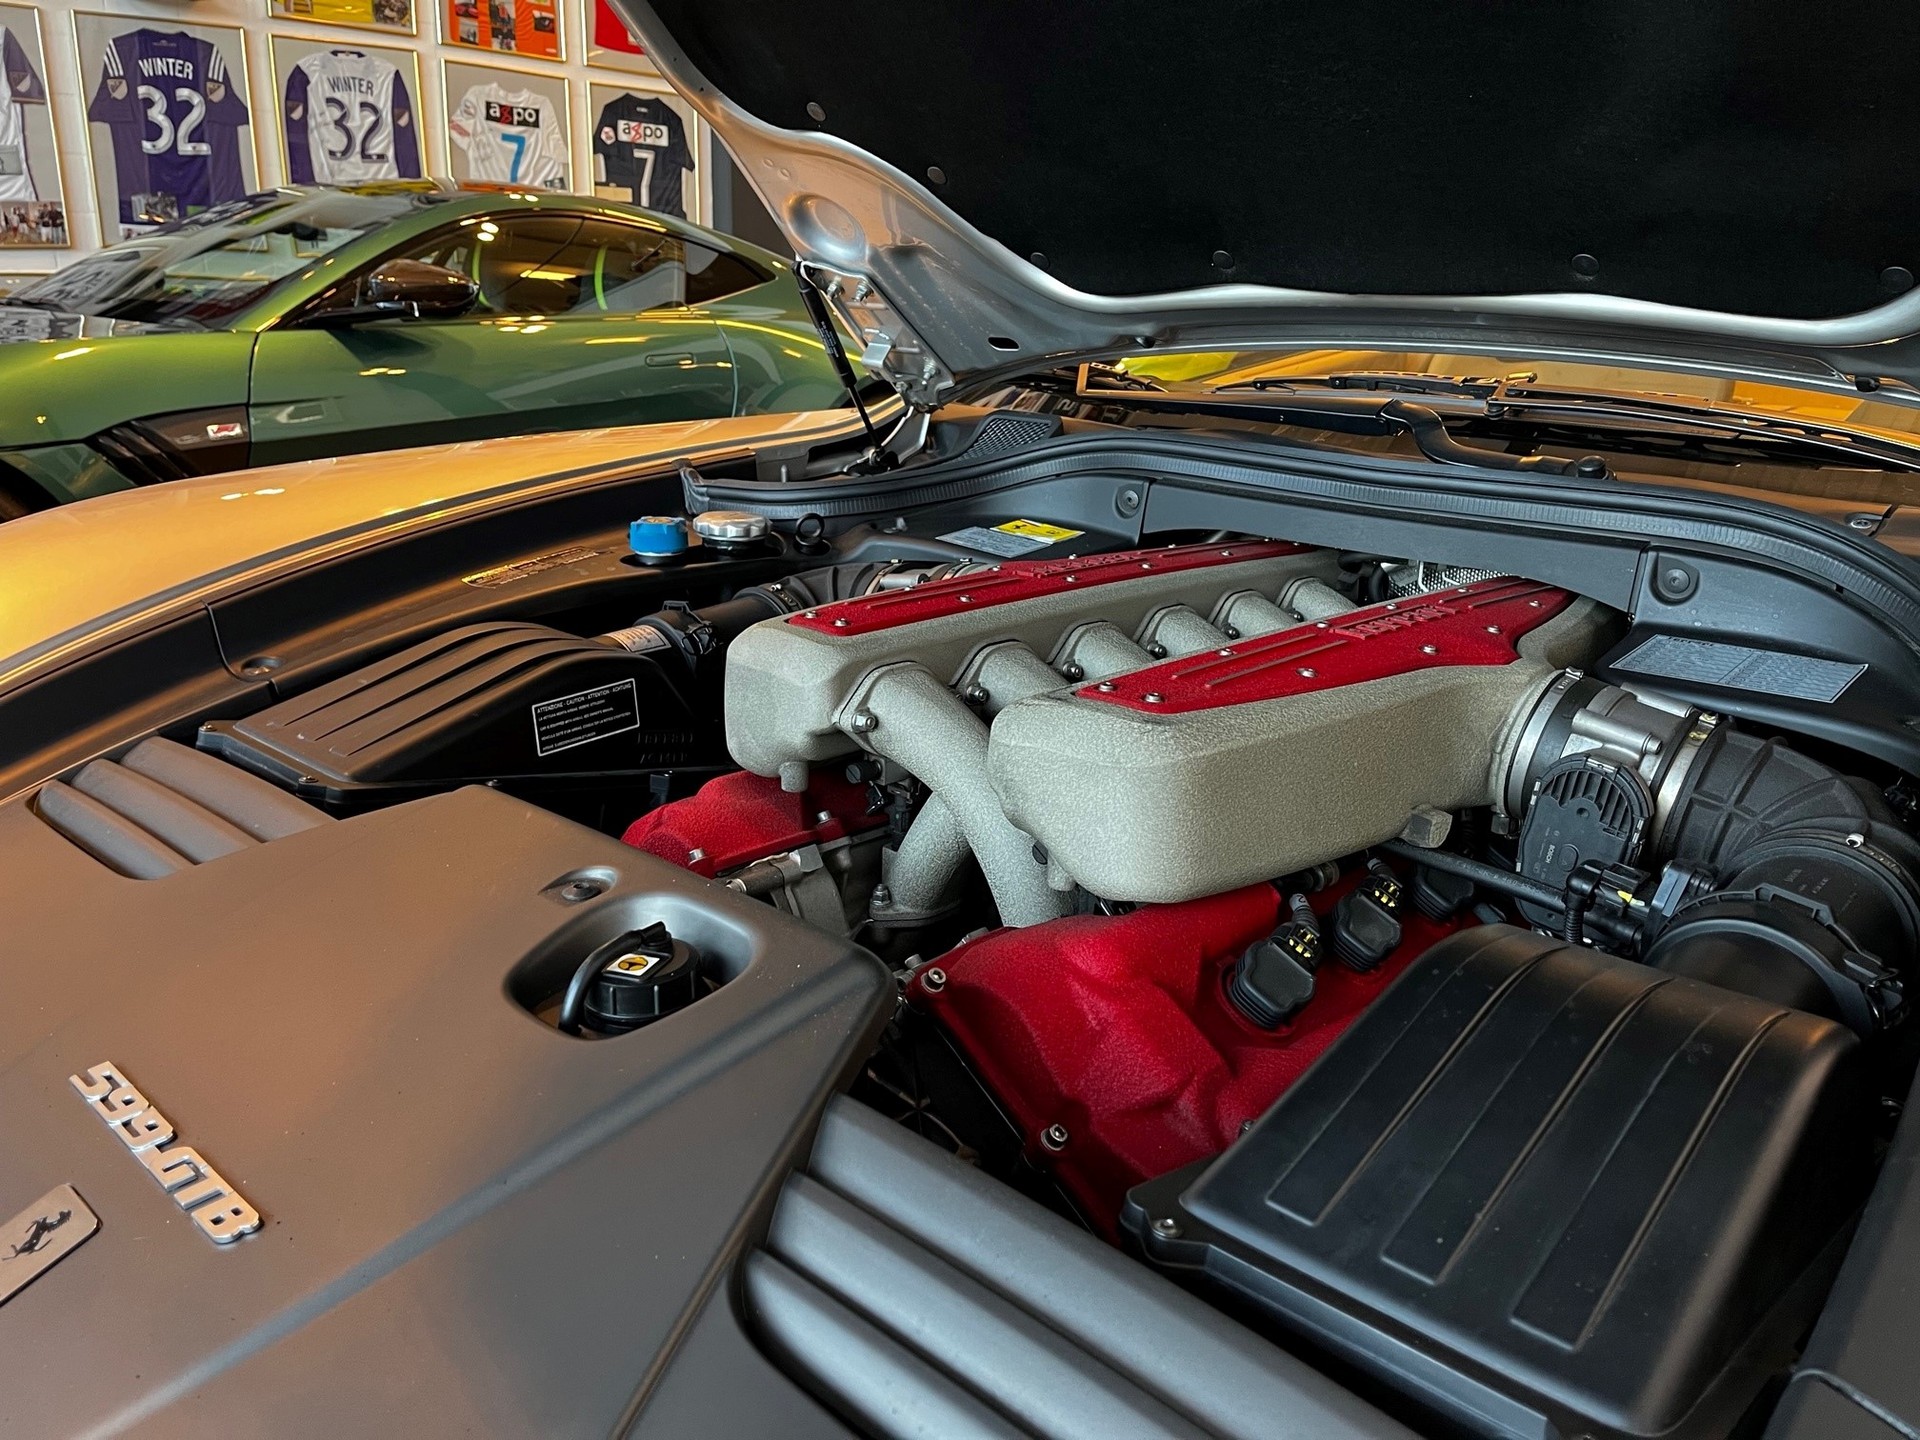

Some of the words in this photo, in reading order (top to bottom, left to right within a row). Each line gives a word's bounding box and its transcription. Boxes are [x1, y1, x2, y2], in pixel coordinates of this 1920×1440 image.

[138, 58, 194, 81] WINTER
[327, 76, 375, 97] WINTER
[137, 84, 212, 156] 32
[324, 97, 389, 164] 32
[501, 132, 526, 183] 7
[632, 148, 656, 208] 7
[1545, 844, 1556, 864] BOSCH
